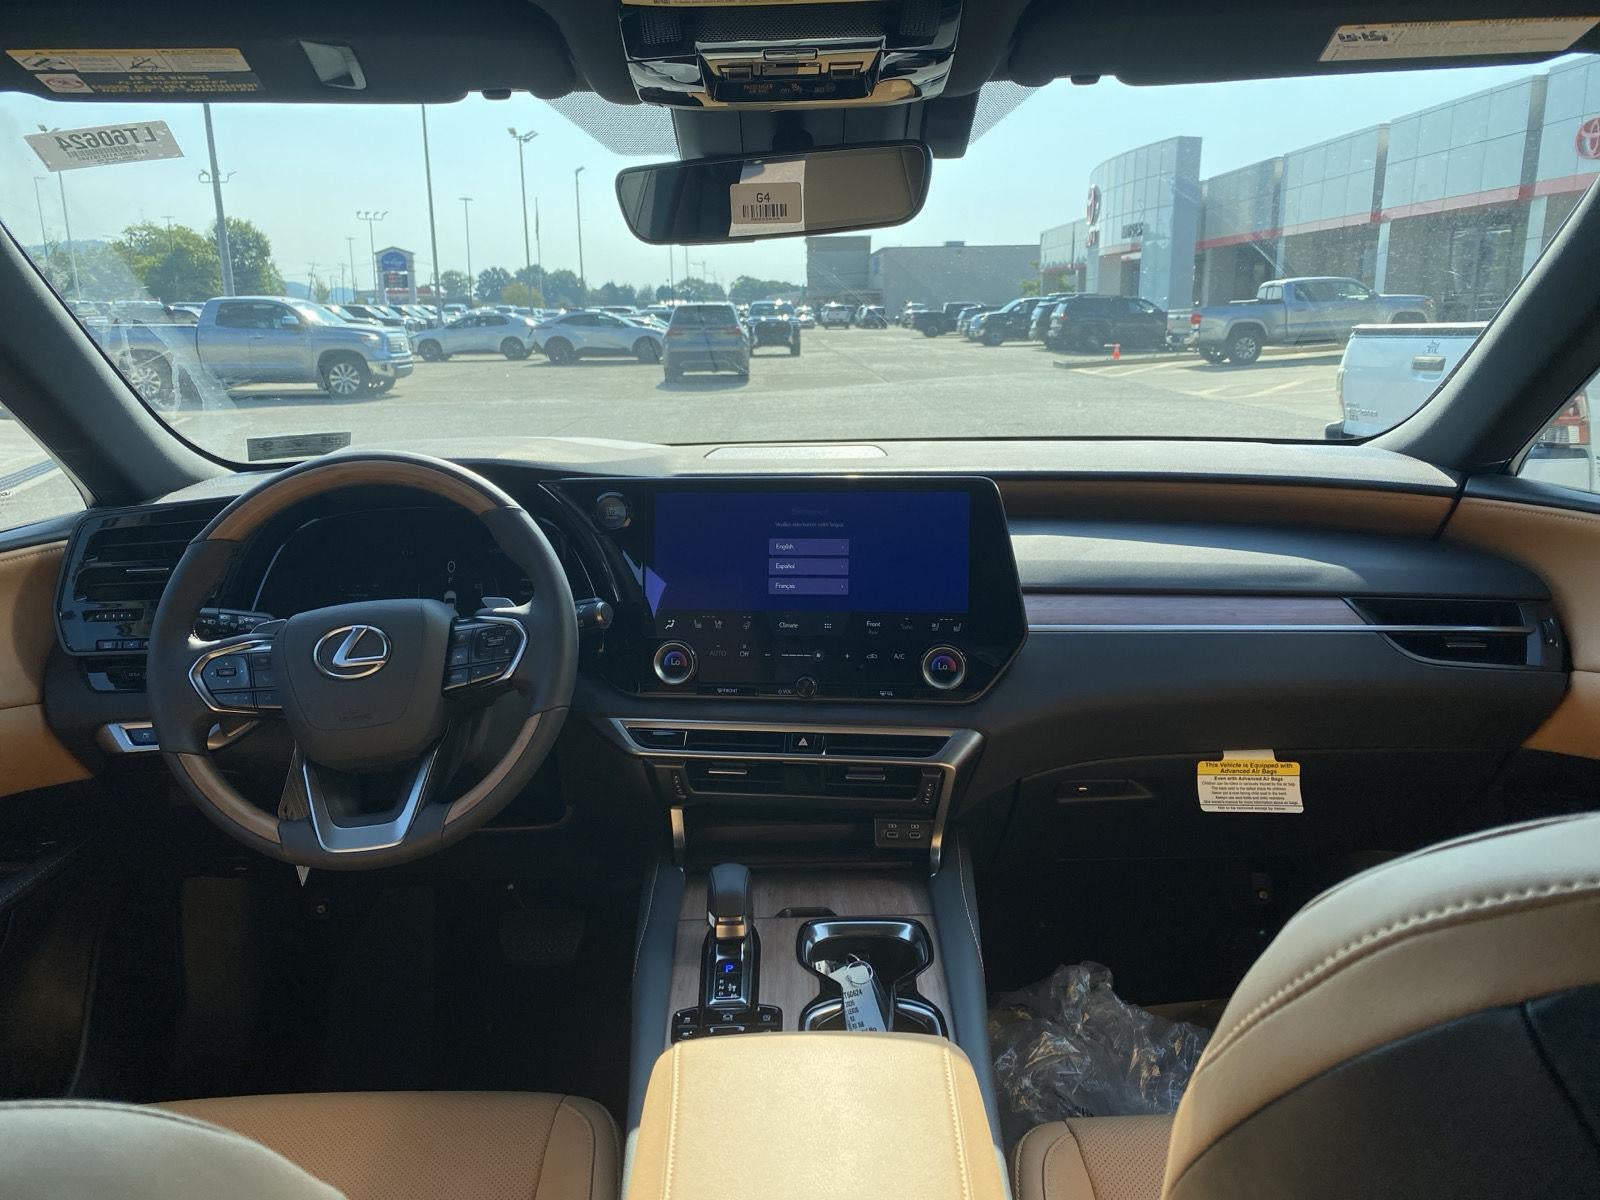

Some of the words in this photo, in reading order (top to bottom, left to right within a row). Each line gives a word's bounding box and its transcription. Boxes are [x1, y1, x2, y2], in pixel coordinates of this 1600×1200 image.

[756, 192, 770, 203] G4
[775, 543, 794, 551] English
[866, 620, 881, 628] Front
[670, 658, 681, 667] Lo
[938, 662, 948, 671] Lo
[725, 964, 734, 973] P
